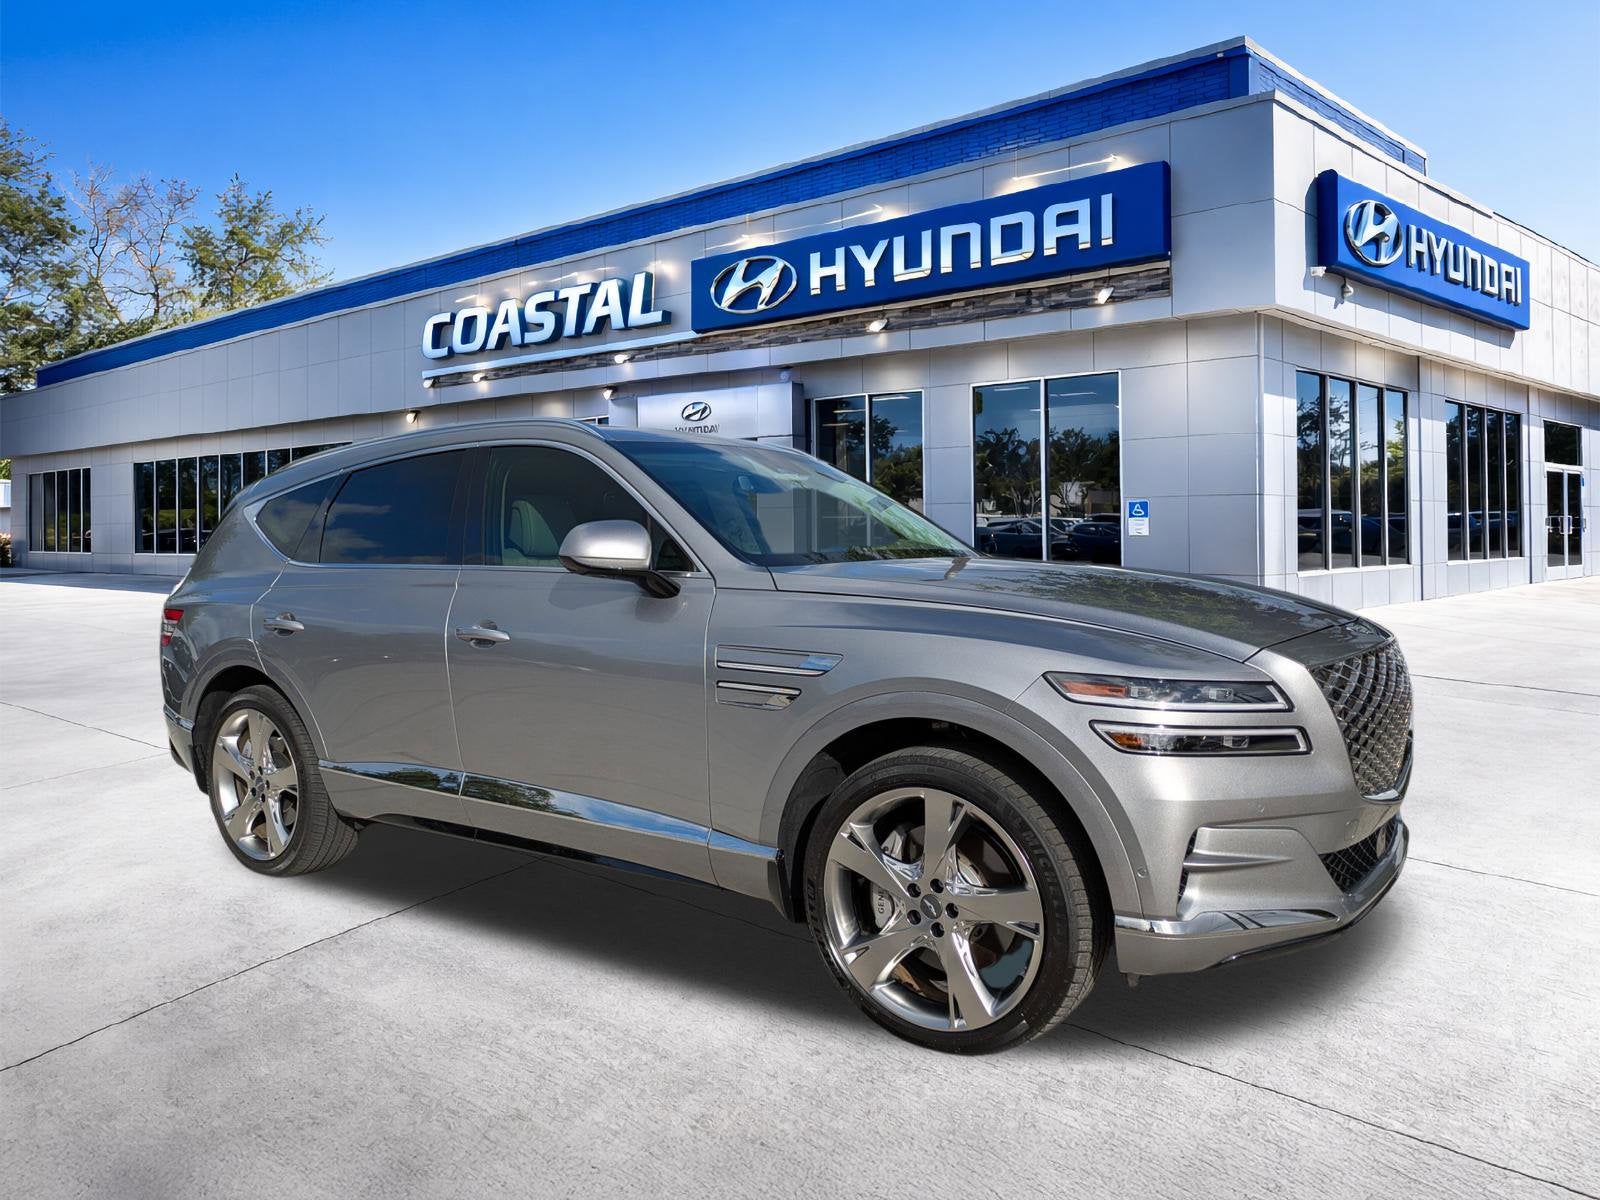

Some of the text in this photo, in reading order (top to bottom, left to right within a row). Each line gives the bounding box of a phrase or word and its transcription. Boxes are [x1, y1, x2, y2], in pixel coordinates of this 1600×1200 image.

[809, 192, 1113, 296] HYUNDAI
[1406, 224, 1522, 306] HYUNDAI
[422, 271, 665, 360] COASTAL
